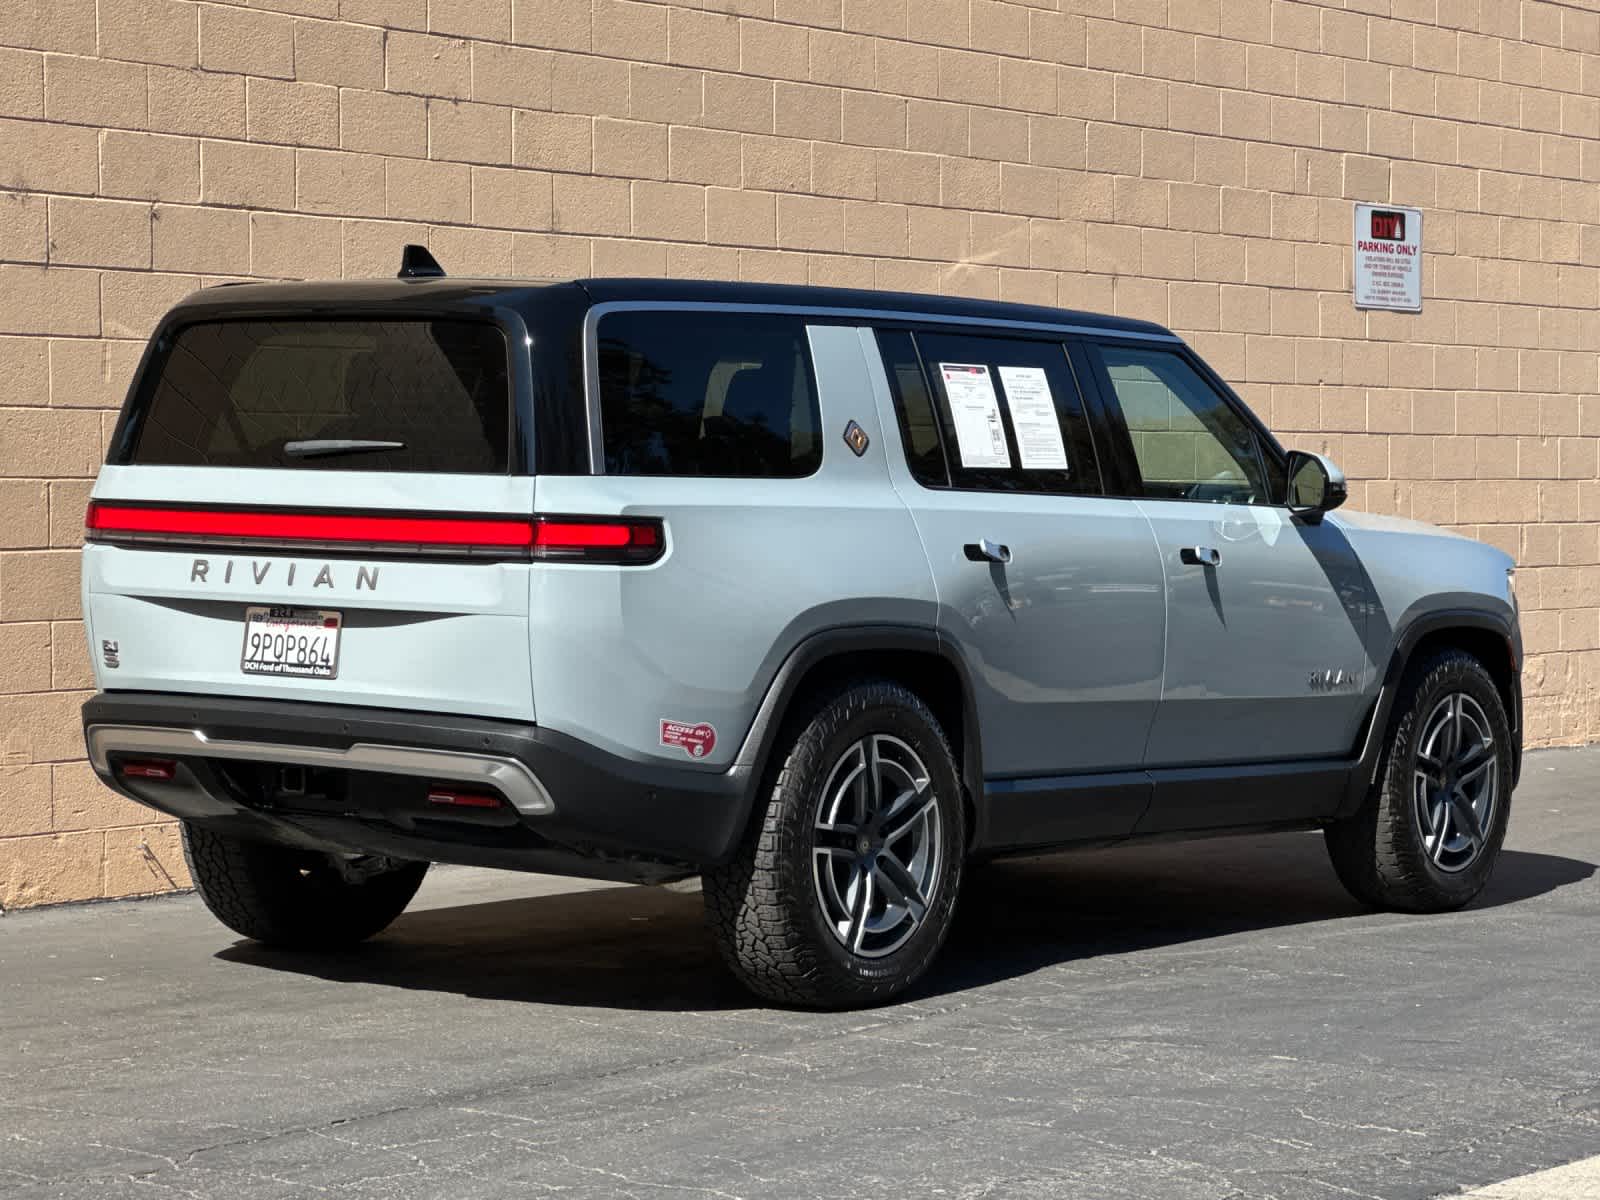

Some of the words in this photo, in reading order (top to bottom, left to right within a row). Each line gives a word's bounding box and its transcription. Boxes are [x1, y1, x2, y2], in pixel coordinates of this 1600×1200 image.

[1358, 240, 1394, 254] PARKING
[1396, 244, 1417, 256] ONLY
[190, 559, 380, 590] RIVIAN
[244, 662, 259, 670] DCH
[259, 663, 274, 671] Ford
[274, 663, 282, 671] of
[282, 664, 313, 674] Thousand
[314, 666, 331, 675] Oaks
